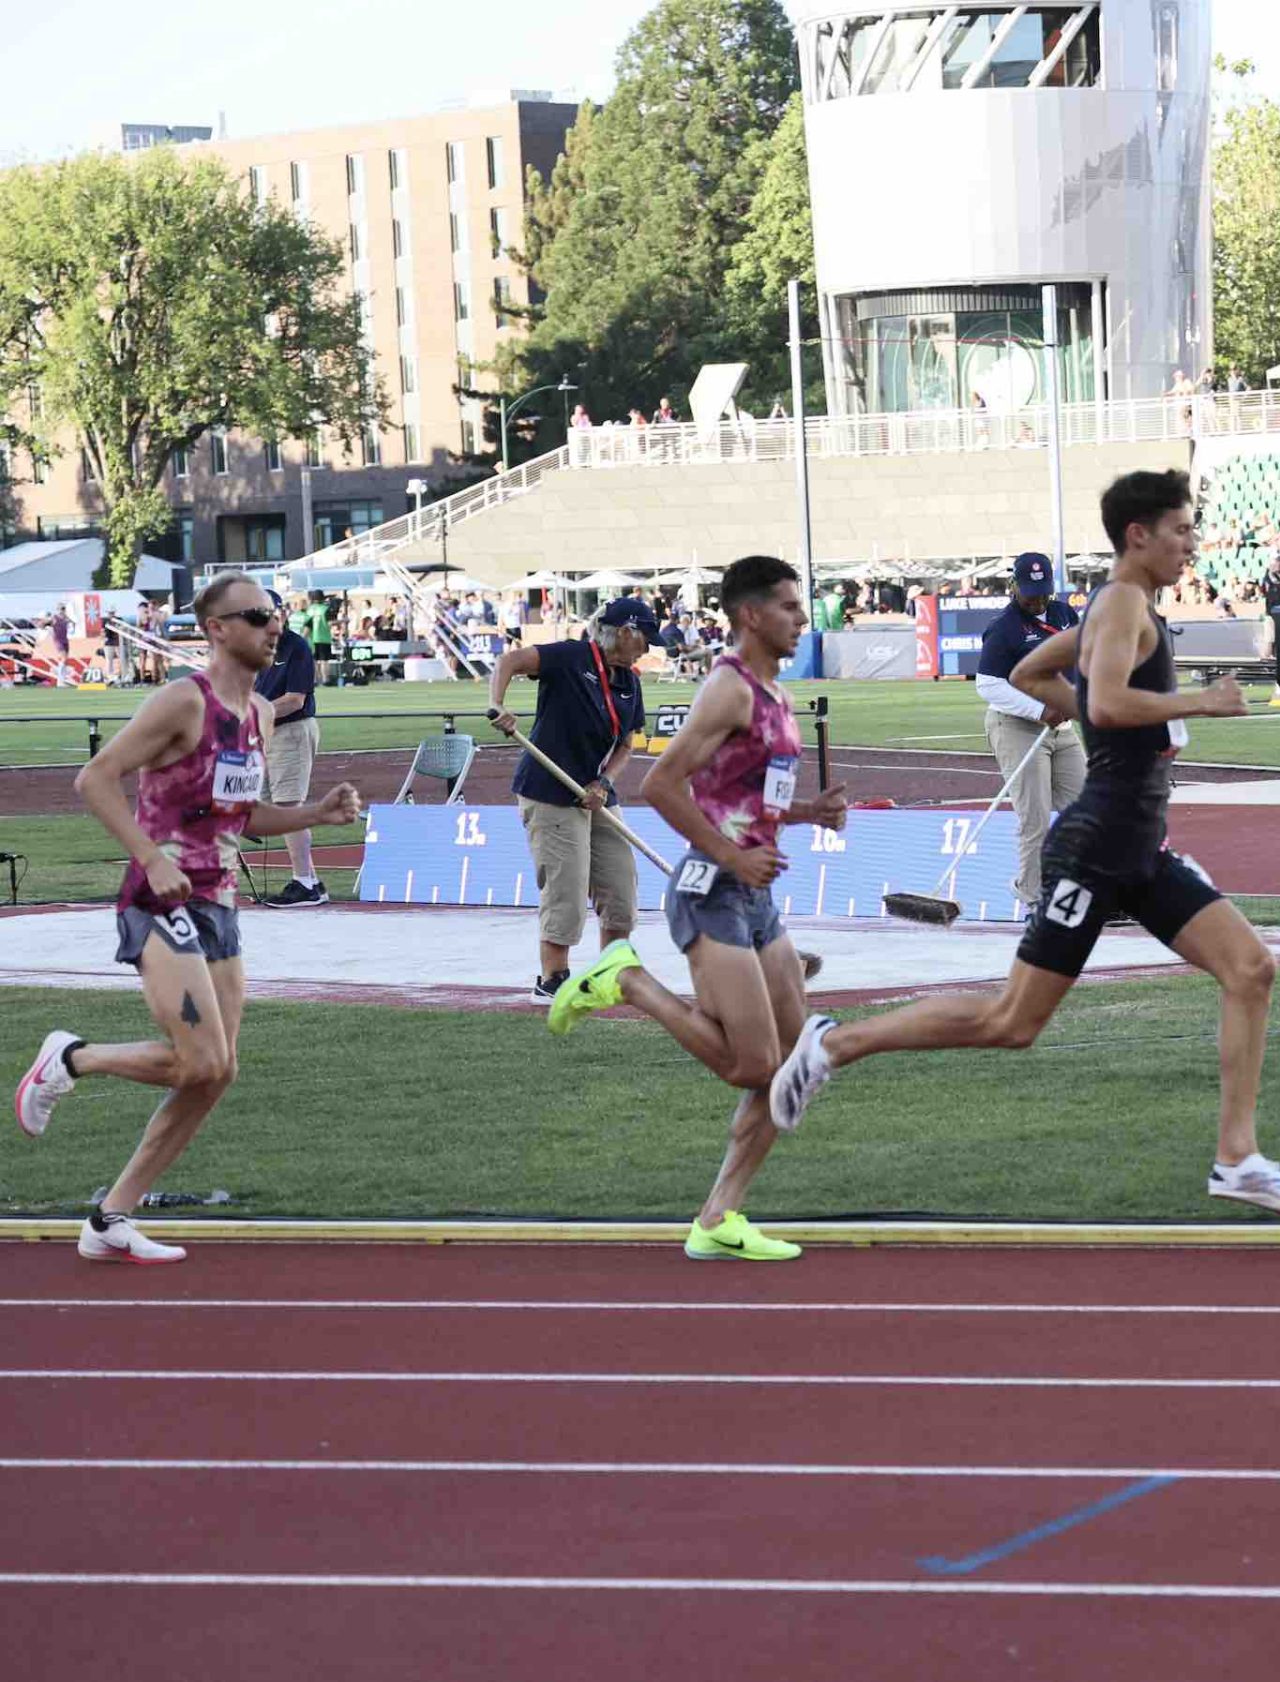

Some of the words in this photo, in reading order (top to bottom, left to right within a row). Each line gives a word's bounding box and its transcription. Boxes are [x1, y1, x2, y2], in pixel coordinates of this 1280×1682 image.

[940, 598, 967, 610] LUKE
[85, 668, 101, 681] 70
[680, 862, 708, 890] 22
[1053, 887, 1081, 921] 4
[164, 911, 192, 938] 5
